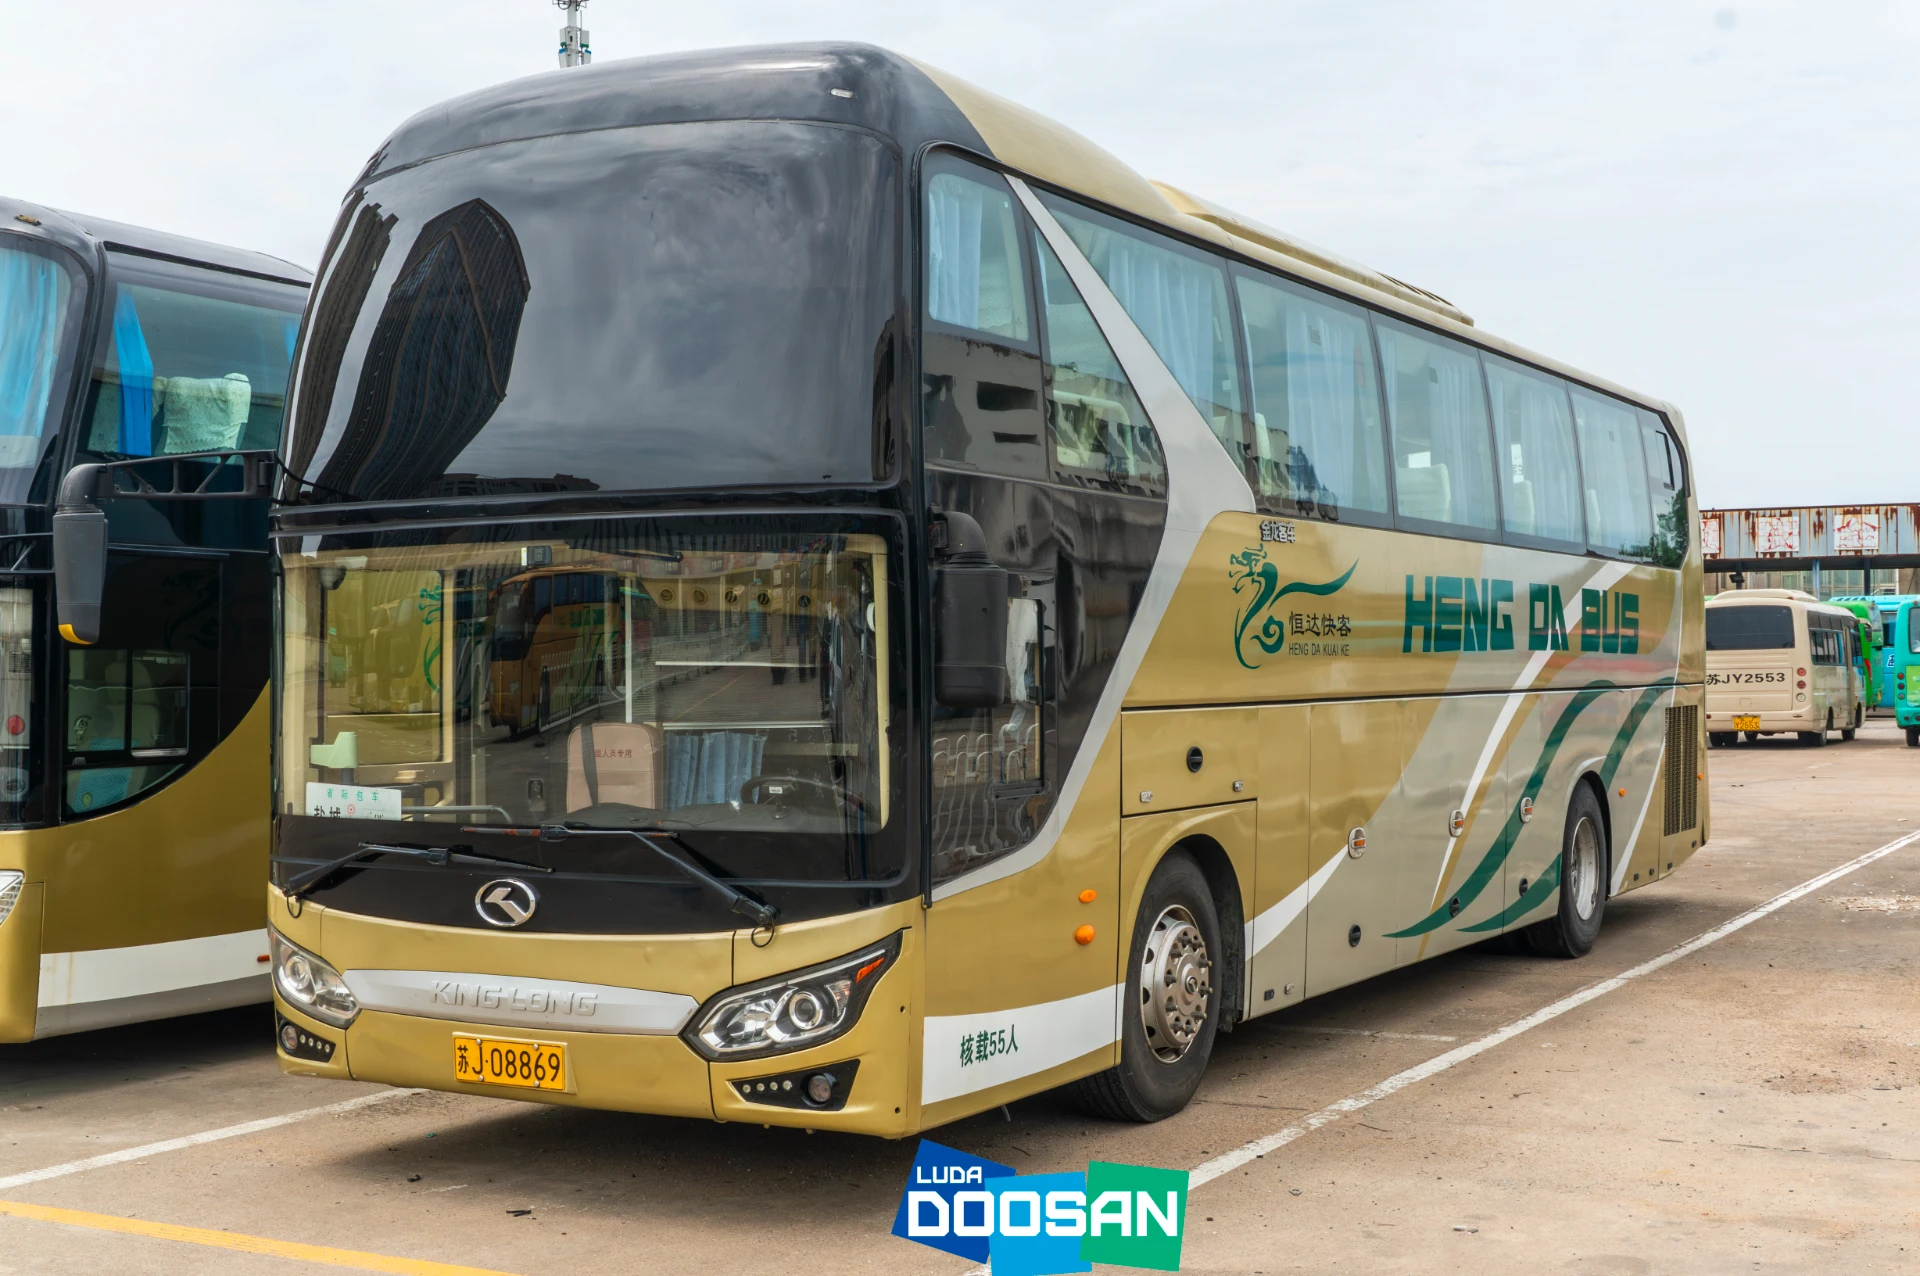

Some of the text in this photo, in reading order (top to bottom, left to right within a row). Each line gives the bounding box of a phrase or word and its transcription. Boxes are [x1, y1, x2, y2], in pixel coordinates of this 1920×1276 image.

[1261, 520, 1296, 543] 金龙客车
[1288, 611, 1351, 637] 恒达快客
[1403, 574, 1640, 655] HENG DA BUS
[1288, 642, 1350, 657] HENG DA KUAI KE
[1706, 672, 1786, 685] 苏JY2553
[594, 748, 632, 758] 组人员专用
[430, 980, 599, 1016] KING LONG
[959, 1023, 1019, 1068] 核载55人
